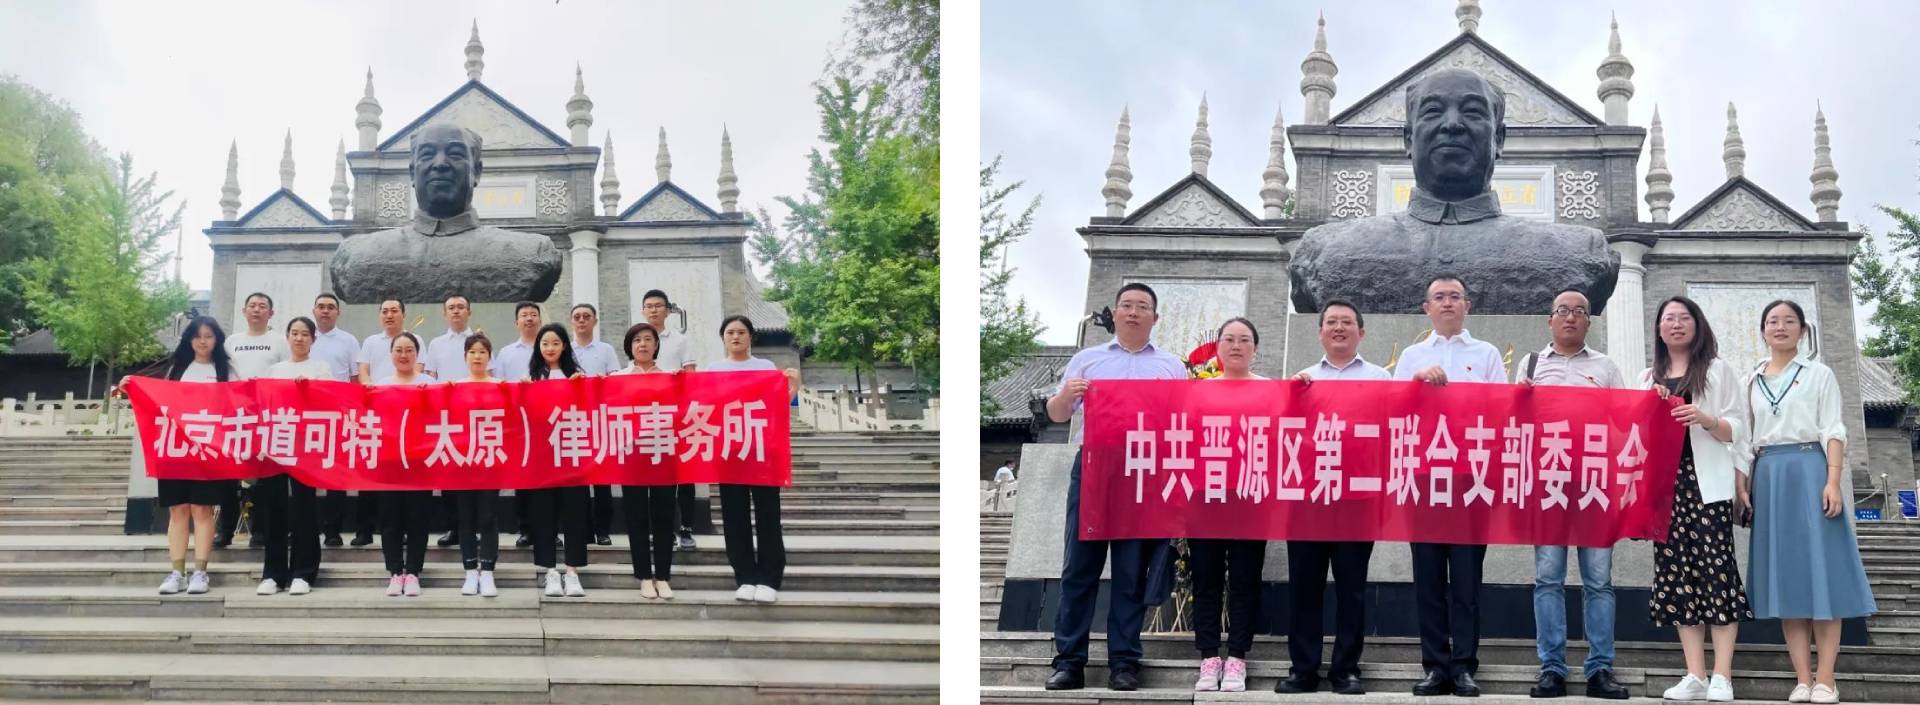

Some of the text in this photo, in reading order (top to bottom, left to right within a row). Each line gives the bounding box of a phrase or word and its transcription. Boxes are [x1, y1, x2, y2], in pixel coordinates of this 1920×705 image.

[234, 344, 271, 352] FASHION
[1124, 411, 1648, 512] 中共晋源区第二联合支部委员会
